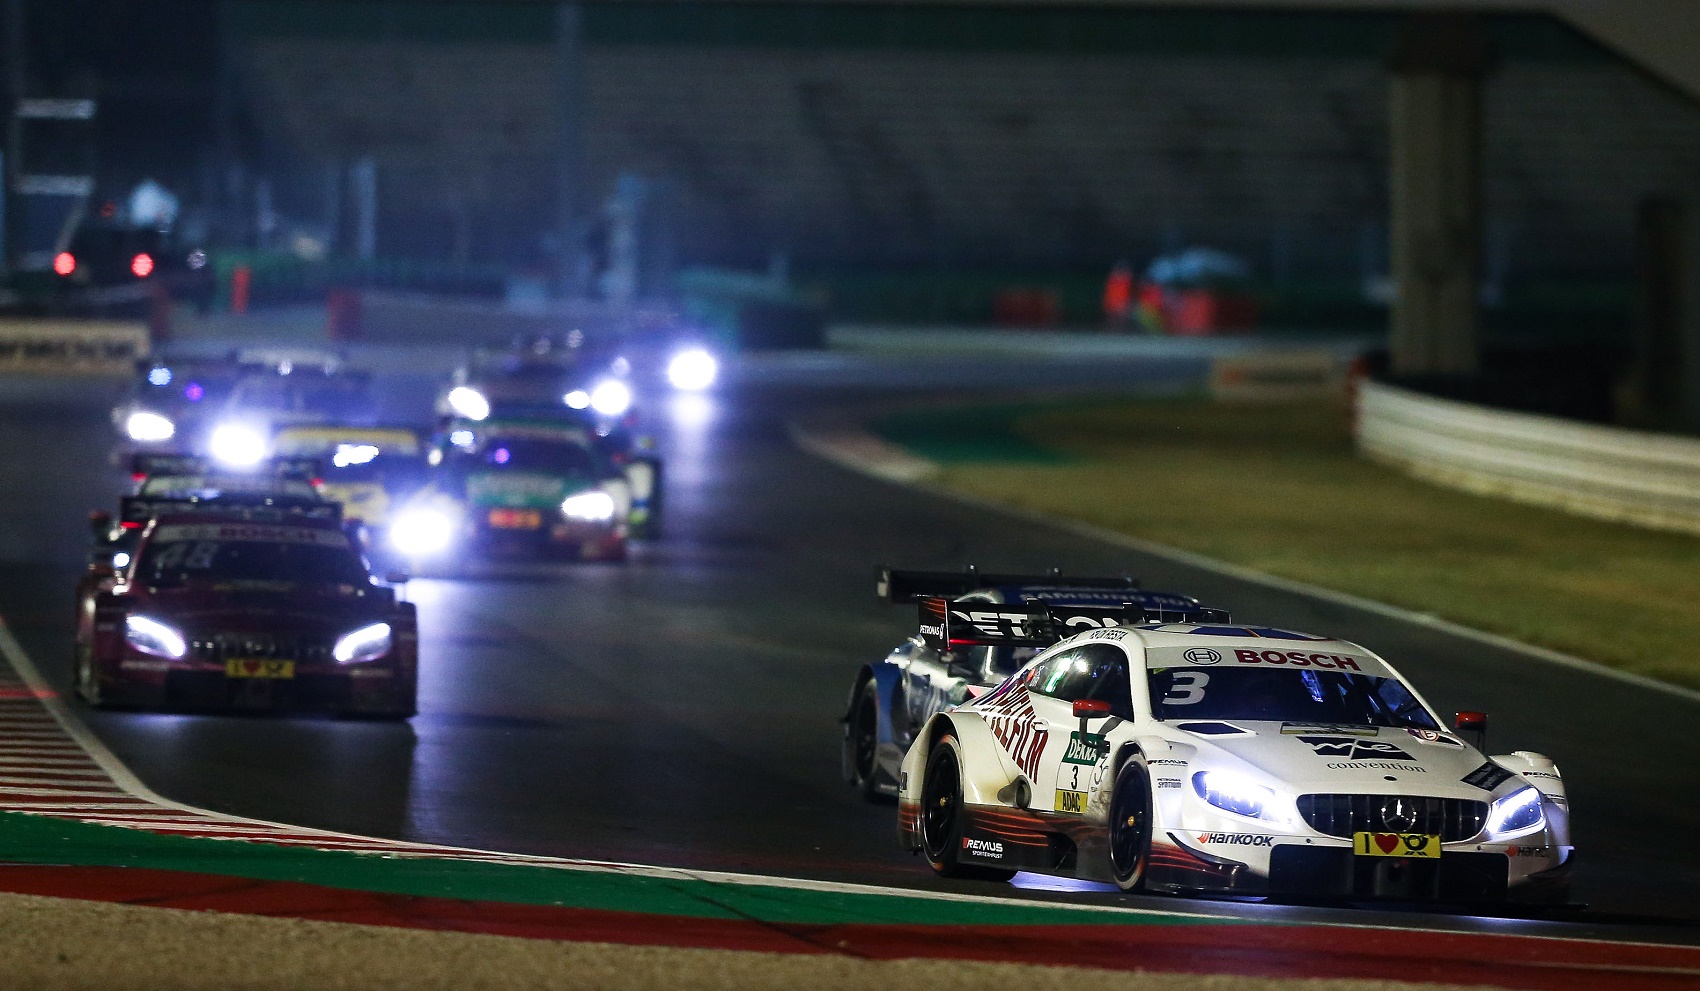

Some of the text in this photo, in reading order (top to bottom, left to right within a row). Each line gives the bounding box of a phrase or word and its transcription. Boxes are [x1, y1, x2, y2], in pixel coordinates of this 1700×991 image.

[919, 624, 940, 636] PETRONAS
[1234, 650, 1362, 672] BOSCH
[1162, 671, 1210, 705] 3
[1071, 765, 1079, 790] 3
[1326, 761, 1427, 773] convention
[1063, 791, 1080, 812] ADAC
[966, 839, 1004, 852] REMUS
